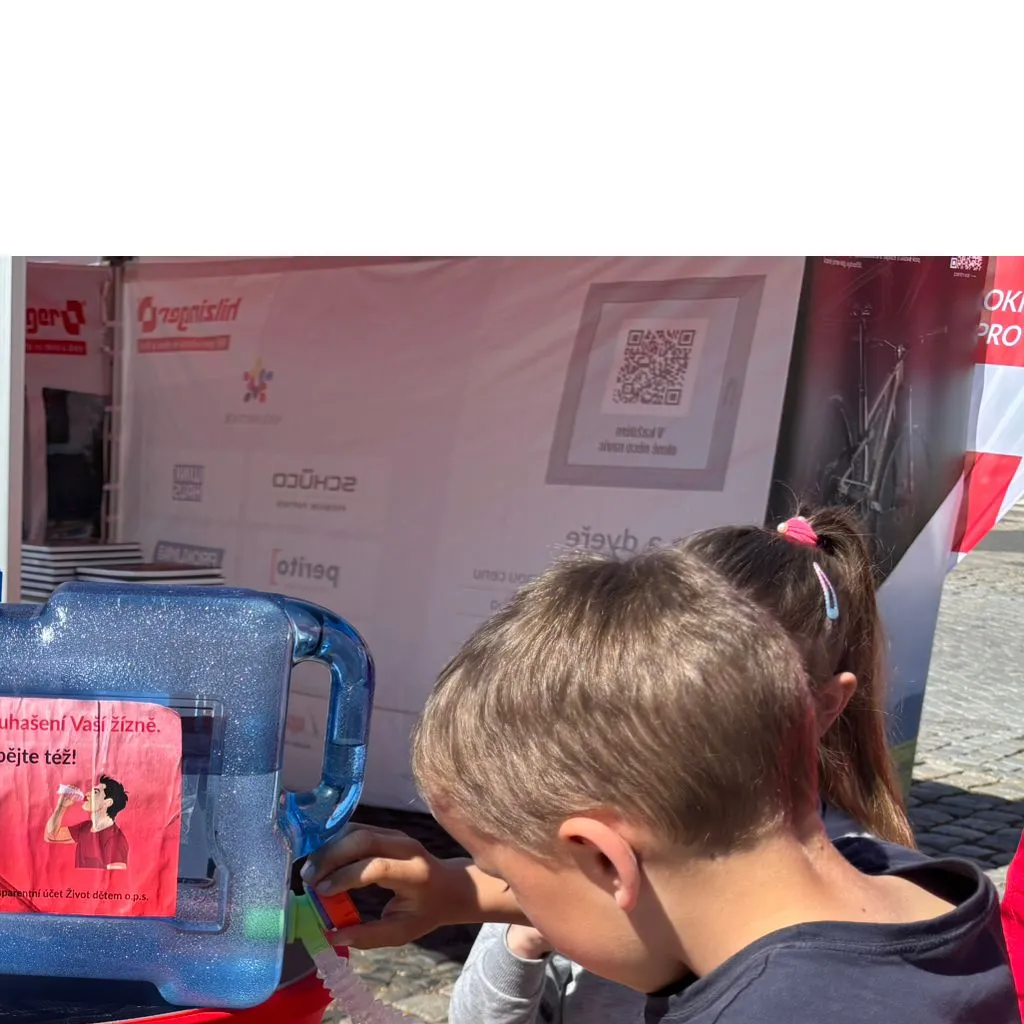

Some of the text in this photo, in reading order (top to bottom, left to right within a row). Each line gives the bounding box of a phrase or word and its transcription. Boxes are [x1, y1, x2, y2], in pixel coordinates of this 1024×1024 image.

[983, 289, 1024, 313] OK
[0, 713, 66, 732] uhašení
[70, 715, 106, 733] Vaší
[110, 716, 161, 733] žízně.
[45, 748, 77, 765] též!
[43, 889, 62, 899] účet
[66, 887, 91, 899] Život
[93, 889, 122, 900] dětem
[125, 893, 149, 903] o.p.s.
